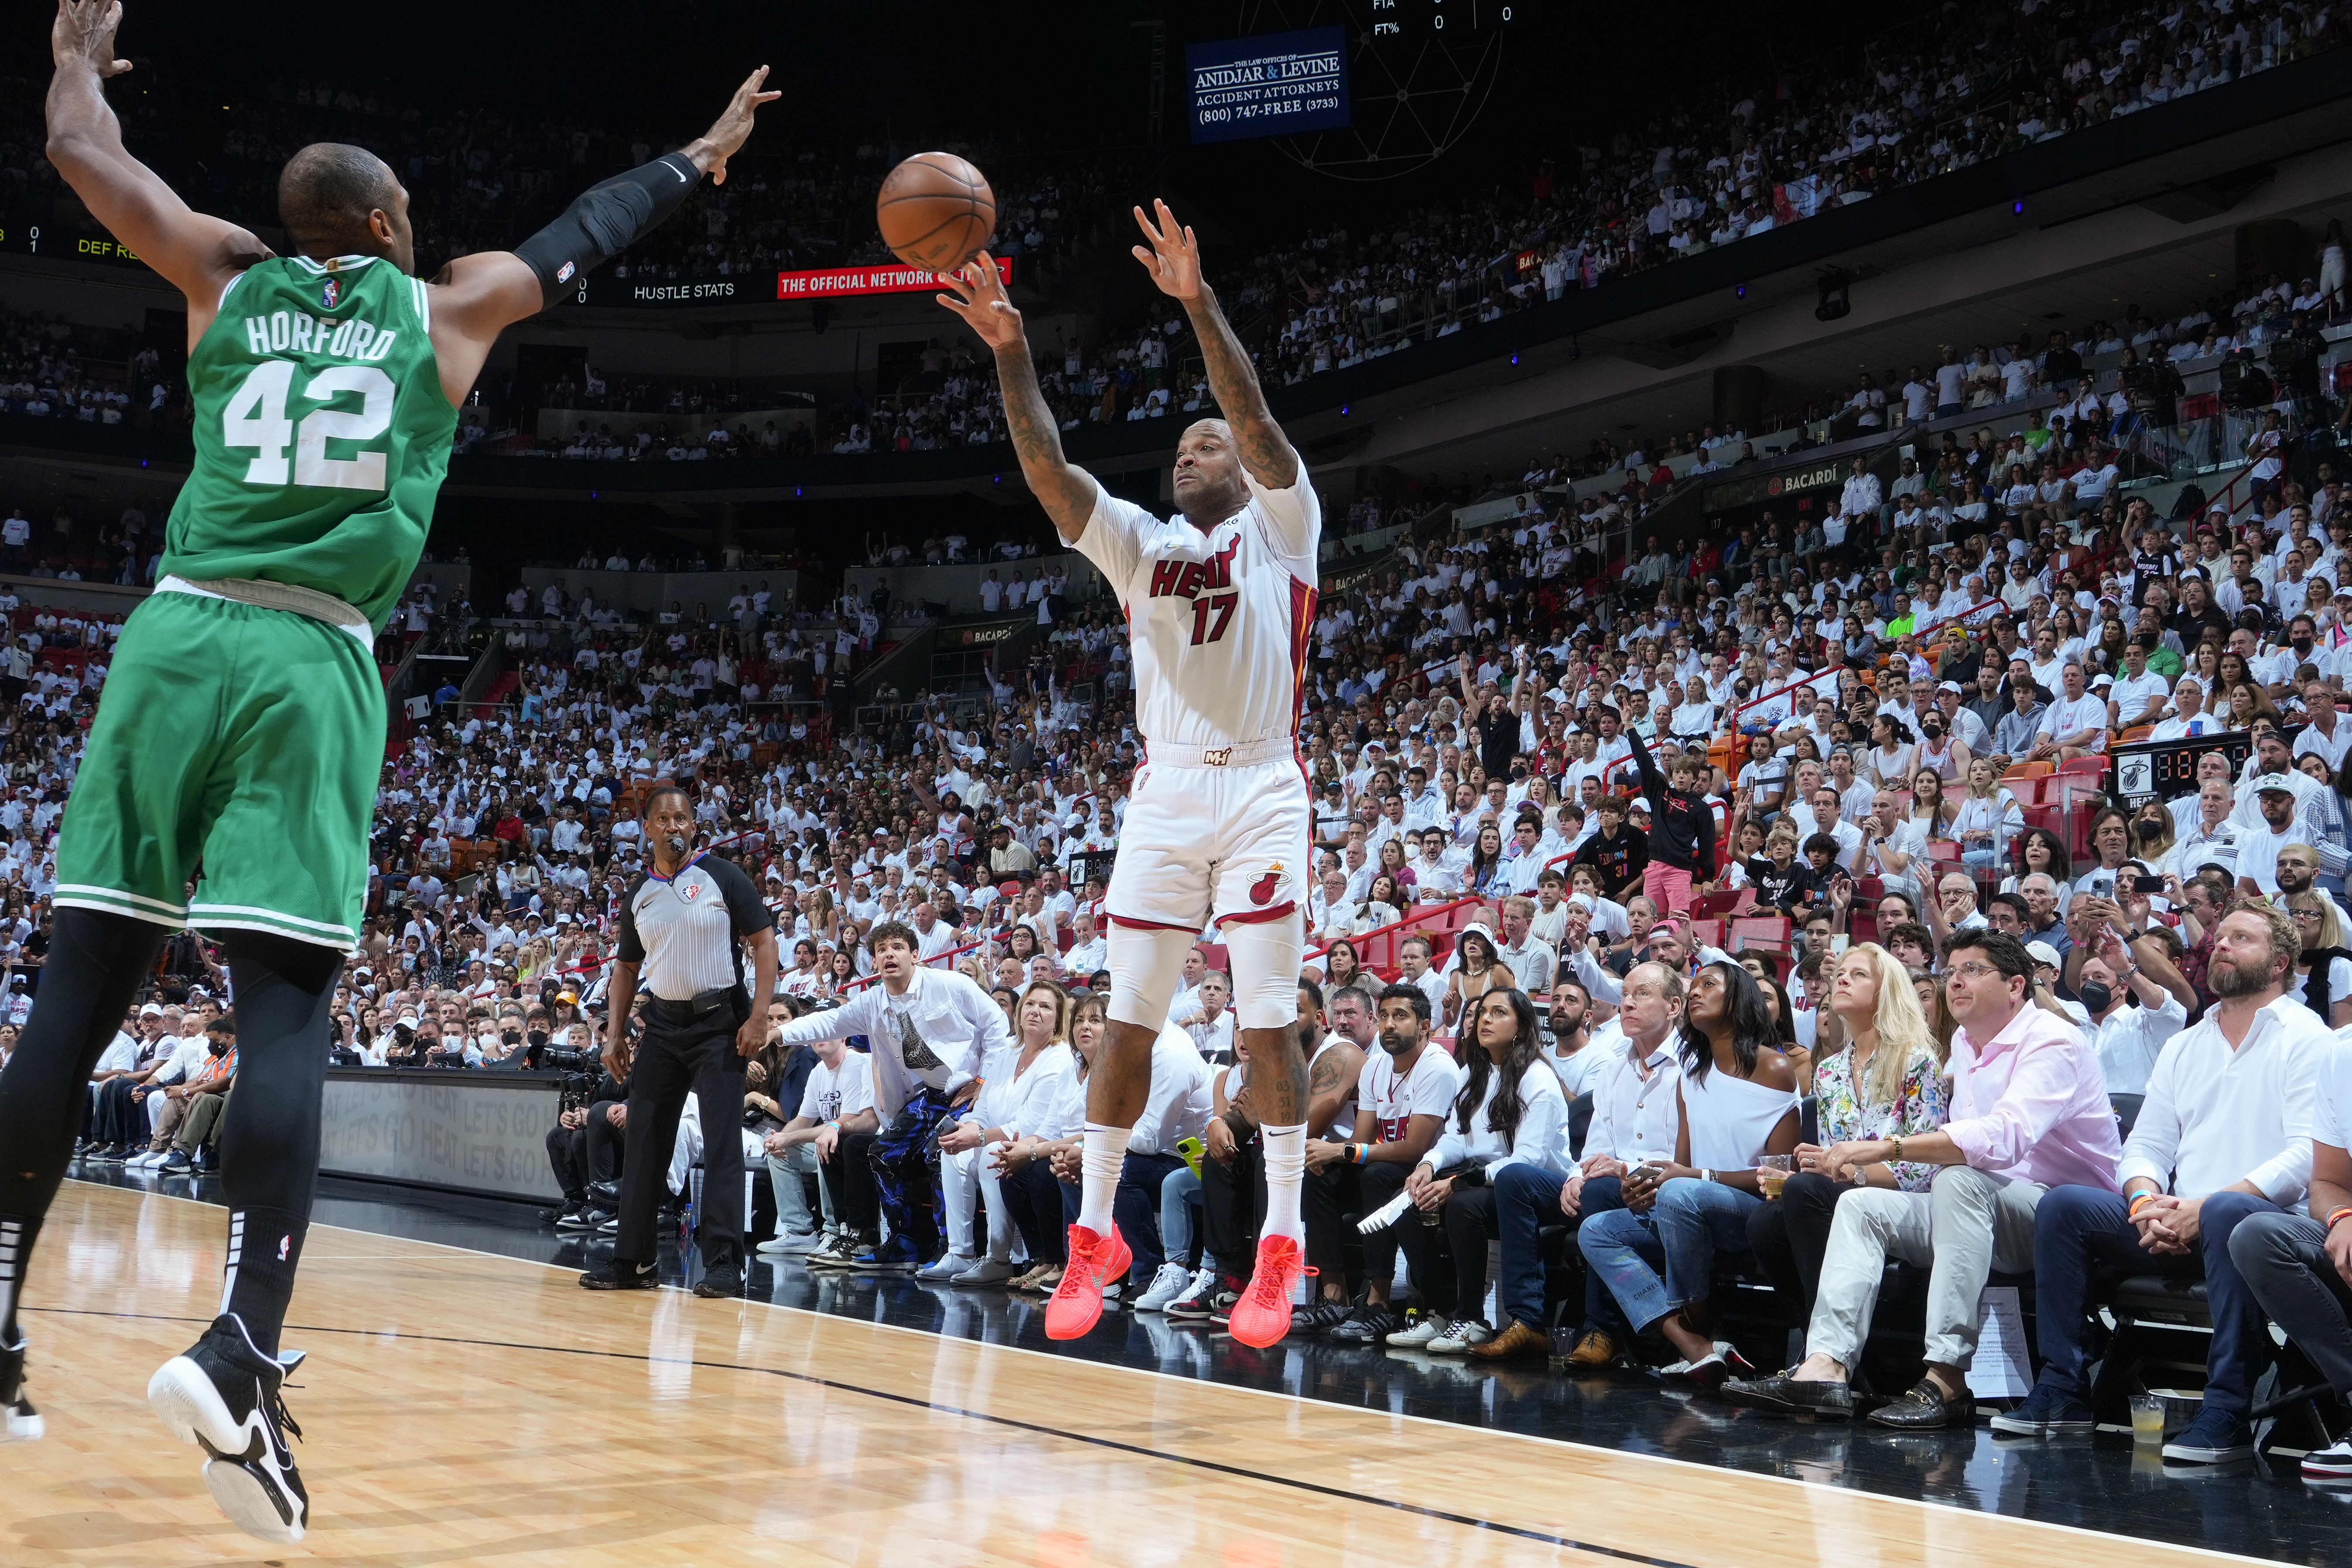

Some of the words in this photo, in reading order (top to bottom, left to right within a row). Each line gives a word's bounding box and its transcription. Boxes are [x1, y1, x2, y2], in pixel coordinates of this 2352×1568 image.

[1374, 0, 1395, 10] FTA
[1503, 7, 1511, 20] 0
[1375, 22, 1399, 35] FT%
[1435, 15, 1443, 29] 0
[1263, 55, 1287, 64] OFFICES
[1195, 67, 1265, 88] ANIDJAR
[1267, 65, 1279, 79] &
[1281, 57, 1340, 78] LEVINE
[1197, 89, 1261, 106] ACCIDENT
[1264, 80, 1339, 98] ATTORNEYS
[1200, 107, 1231, 125] (800)
[1236, 100, 1302, 119] 747-FREE
[1306, 96, 1338, 112] (3733)
[30, 226, 39, 239] 0
[30, 240, 36, 253] 1
[79, 239, 112, 255] DEF
[783, 277, 806, 293] THE
[810, 274, 865, 290] OFFICIAL
[871, 271, 933, 287] NETWORK
[578, 291, 586, 303] 0
[635, 286, 690, 299] HUSTLE
[694, 283, 734, 297] STATS
[246, 311, 397, 361] HORFORD
[222, 360, 396, 491] 42
[1710, 518, 1721, 530] 117
[1150, 533, 1241, 600] HEAT
[1190, 591, 1239, 646] 17
[2130, 798, 2154, 808] HEAT
[1615, 863, 1628, 878] 31
[788, 979, 812, 993] HEAT
[1277, 1079, 1290, 1092] 03
[1280, 1097, 1291, 1108] 31
[464, 1100, 508, 1137] LET'S
[513, 1102, 538, 1139] GO
[340, 1113, 379, 1158] LET'S
[383, 1110, 415, 1156] GO
[421, 1116, 458, 1170] HEAT
[463, 1143, 505, 1181] LET'S
[509, 1147, 536, 1184] GO
[1658, 1200, 1681, 1214] CHANEL
[1659, 1216, 1678, 1226] CHANEL
[1634, 1282, 1659, 1301] CHANEL
